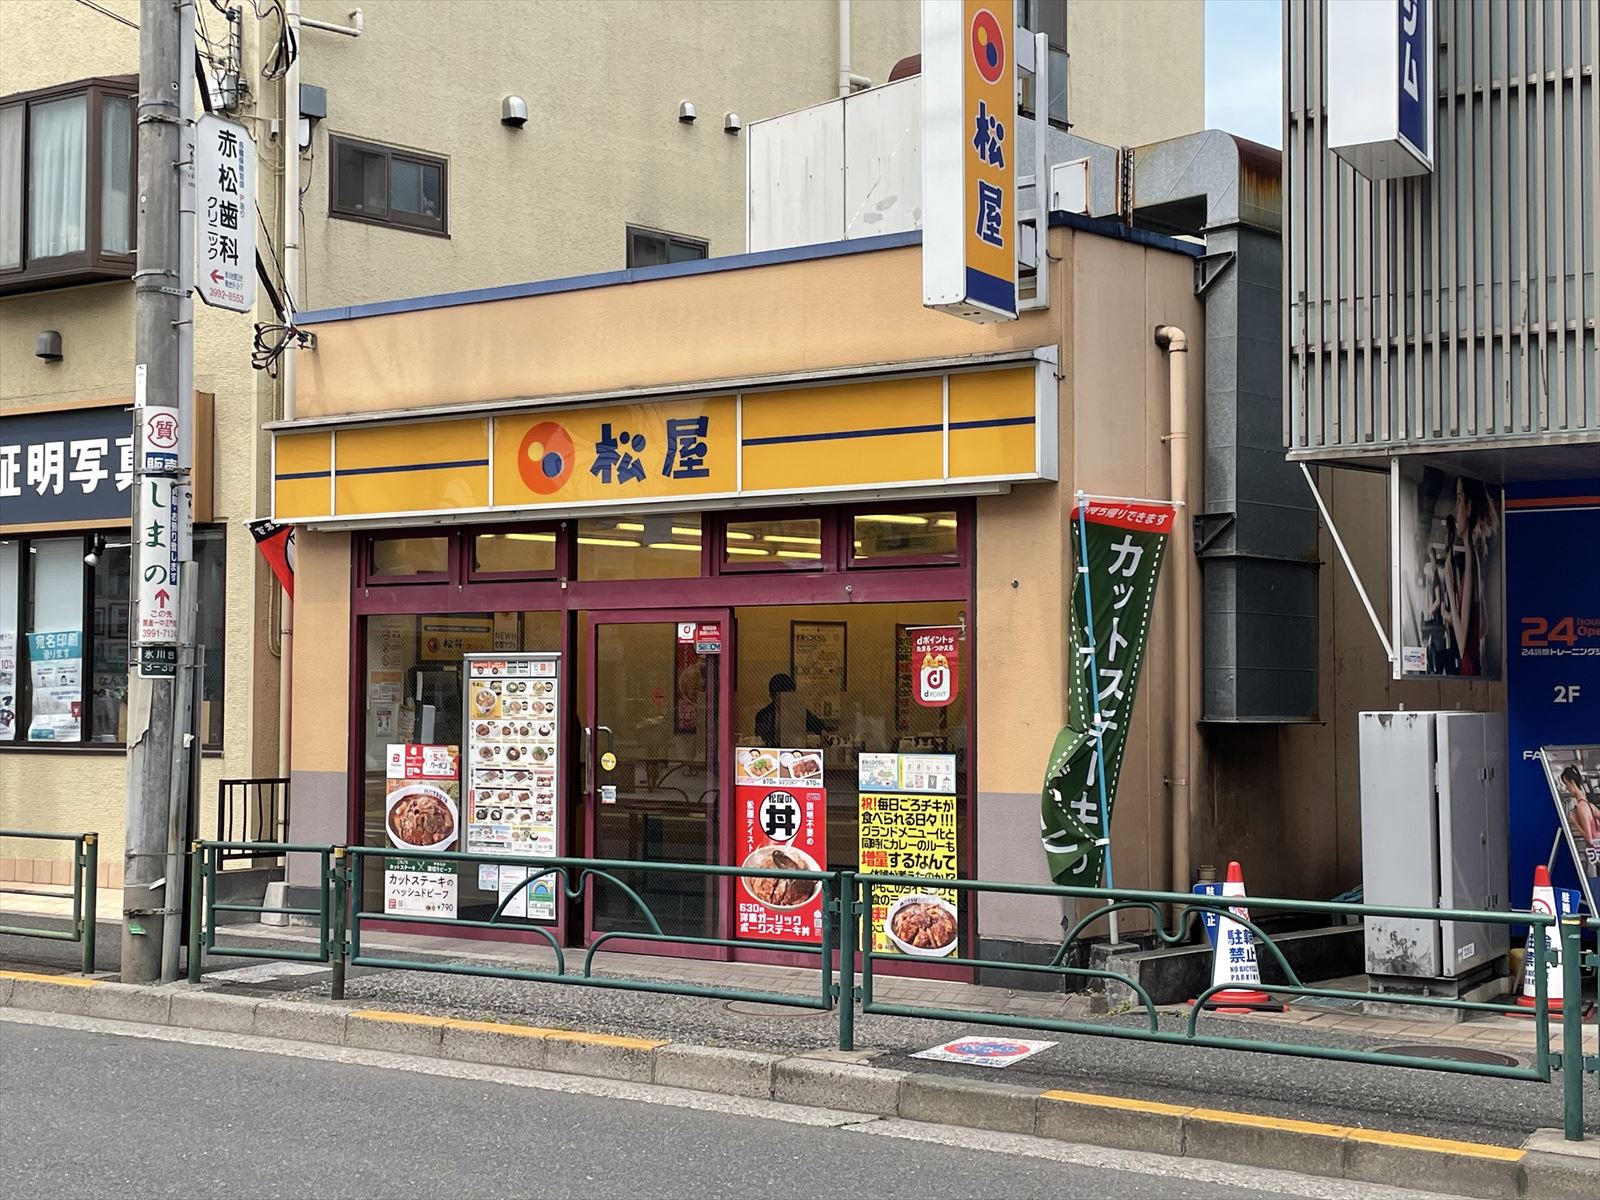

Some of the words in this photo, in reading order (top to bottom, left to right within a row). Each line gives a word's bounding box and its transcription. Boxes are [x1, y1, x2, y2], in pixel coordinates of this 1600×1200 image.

[972, 99, 1005, 250] 松屋
[217, 129, 239, 266] 赤松歯科
[207, 196, 219, 260] クリニック
[208, 287, 245, 304] 3992-8552
[155, 421, 174, 441] 質
[590, 416, 710, 484] 松屋
[1084, 506, 1169, 526] 持ち帰りできます
[145, 481, 168, 585] しまの
[150, 610, 173, 619] この先
[35, 632, 79, 649] 宛名印刷
[916, 635, 955, 645] dポイントが
[1521, 617, 1578, 647] 24
[144, 649, 176, 660] 氷川台
[1553, 685, 1581, 703] 2F
[769, 794, 792, 804] 松屋の
[746, 800, 755, 852] 松屋テイスト
[765, 805, 796, 836] 丼
[861, 825, 955, 840] グランドメニュー化と
[861, 838, 956, 853] 同時にカレーのルーも
[861, 851, 956, 871] 増量するなんて
[389, 873, 454, 888] カットステーキの
[392, 888, 449, 899] ハッシュドビーフ
[739, 903, 765, 913] 630円
[740, 912, 802, 926] 洋風ガーリック
[740, 922, 810, 937] ポークステーキ丼
[1229, 947, 1257, 963] 禁止
